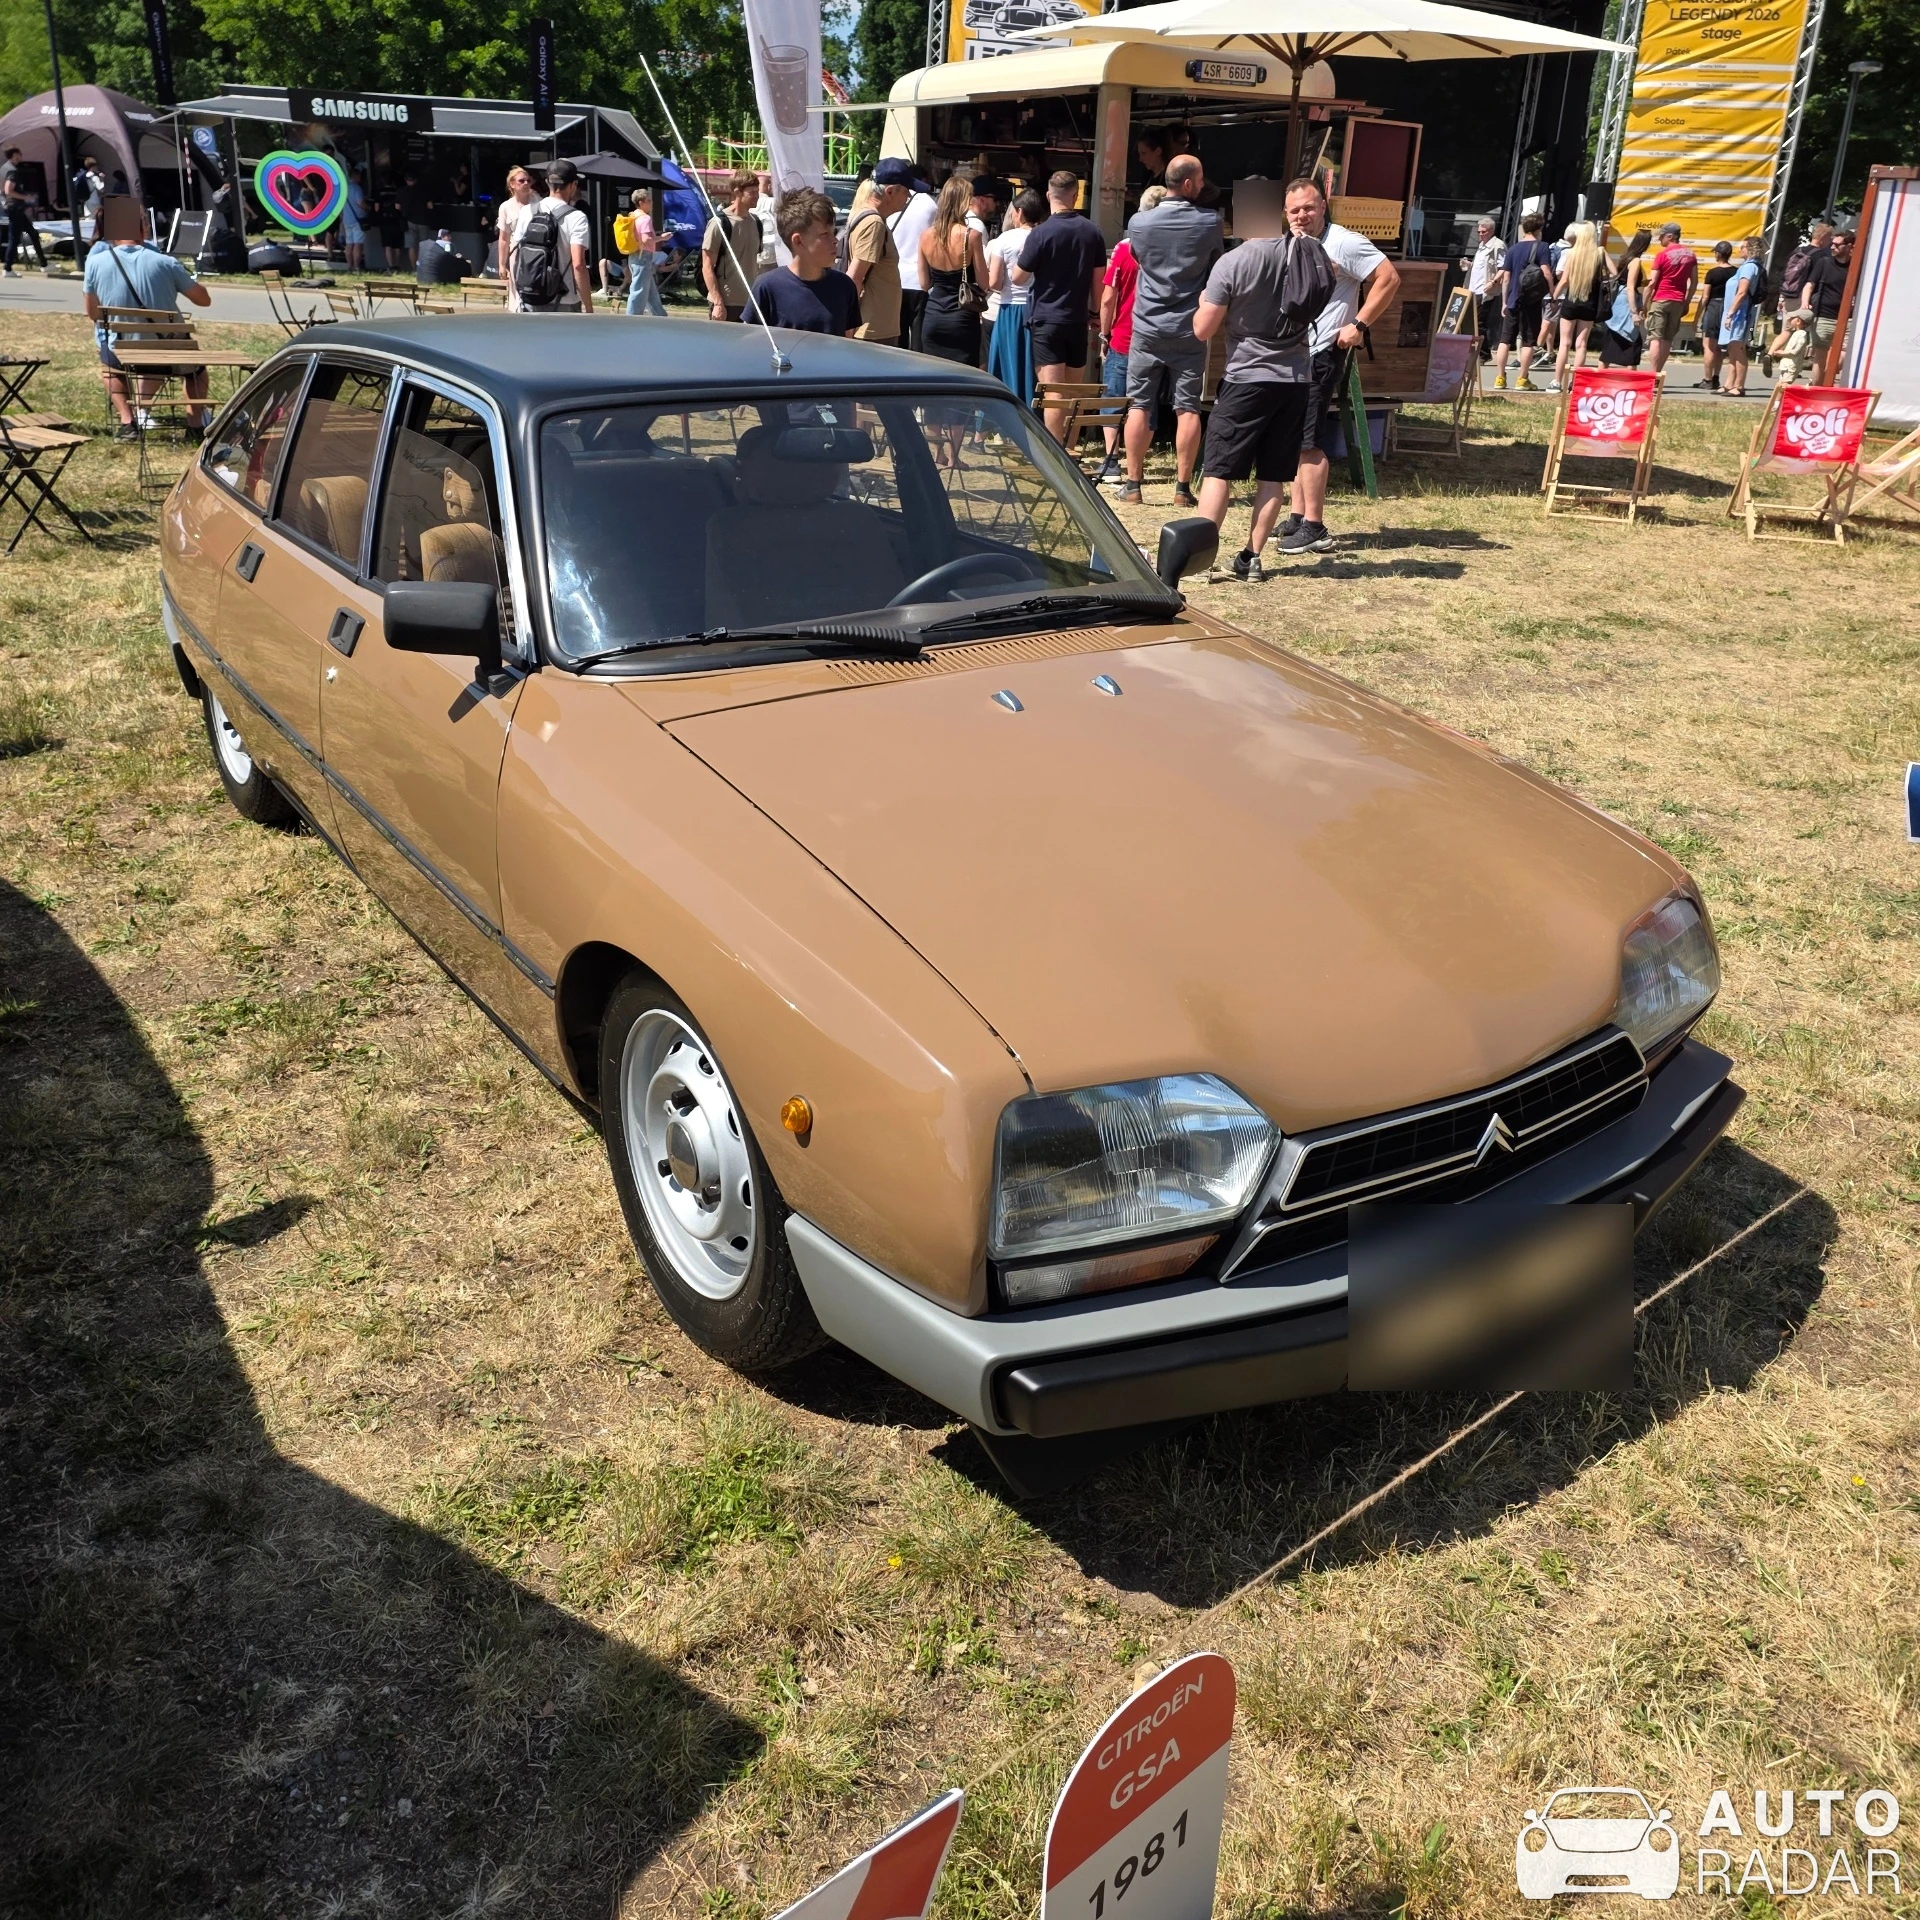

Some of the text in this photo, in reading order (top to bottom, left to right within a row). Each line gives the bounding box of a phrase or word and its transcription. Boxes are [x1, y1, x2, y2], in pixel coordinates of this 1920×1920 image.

[1670, 8, 1780, 21] LEGENDY 2026
[1700, 28, 1742, 40] stage
[1665, 47, 1691, 56] Pátek
[538, 36, 548, 95] Galaxy AI
[1204, 63, 1252, 80] 4SR 6609
[40, 105, 95, 116] SASUNG
[311, 97, 409, 123] SAMSUNG
[1653, 117, 1686, 126] Sobota
[1097, 1673, 1204, 1771] CITROËN
[1110, 1737, 1181, 1810] GSA
[1089, 1808, 1189, 1920] 1981
